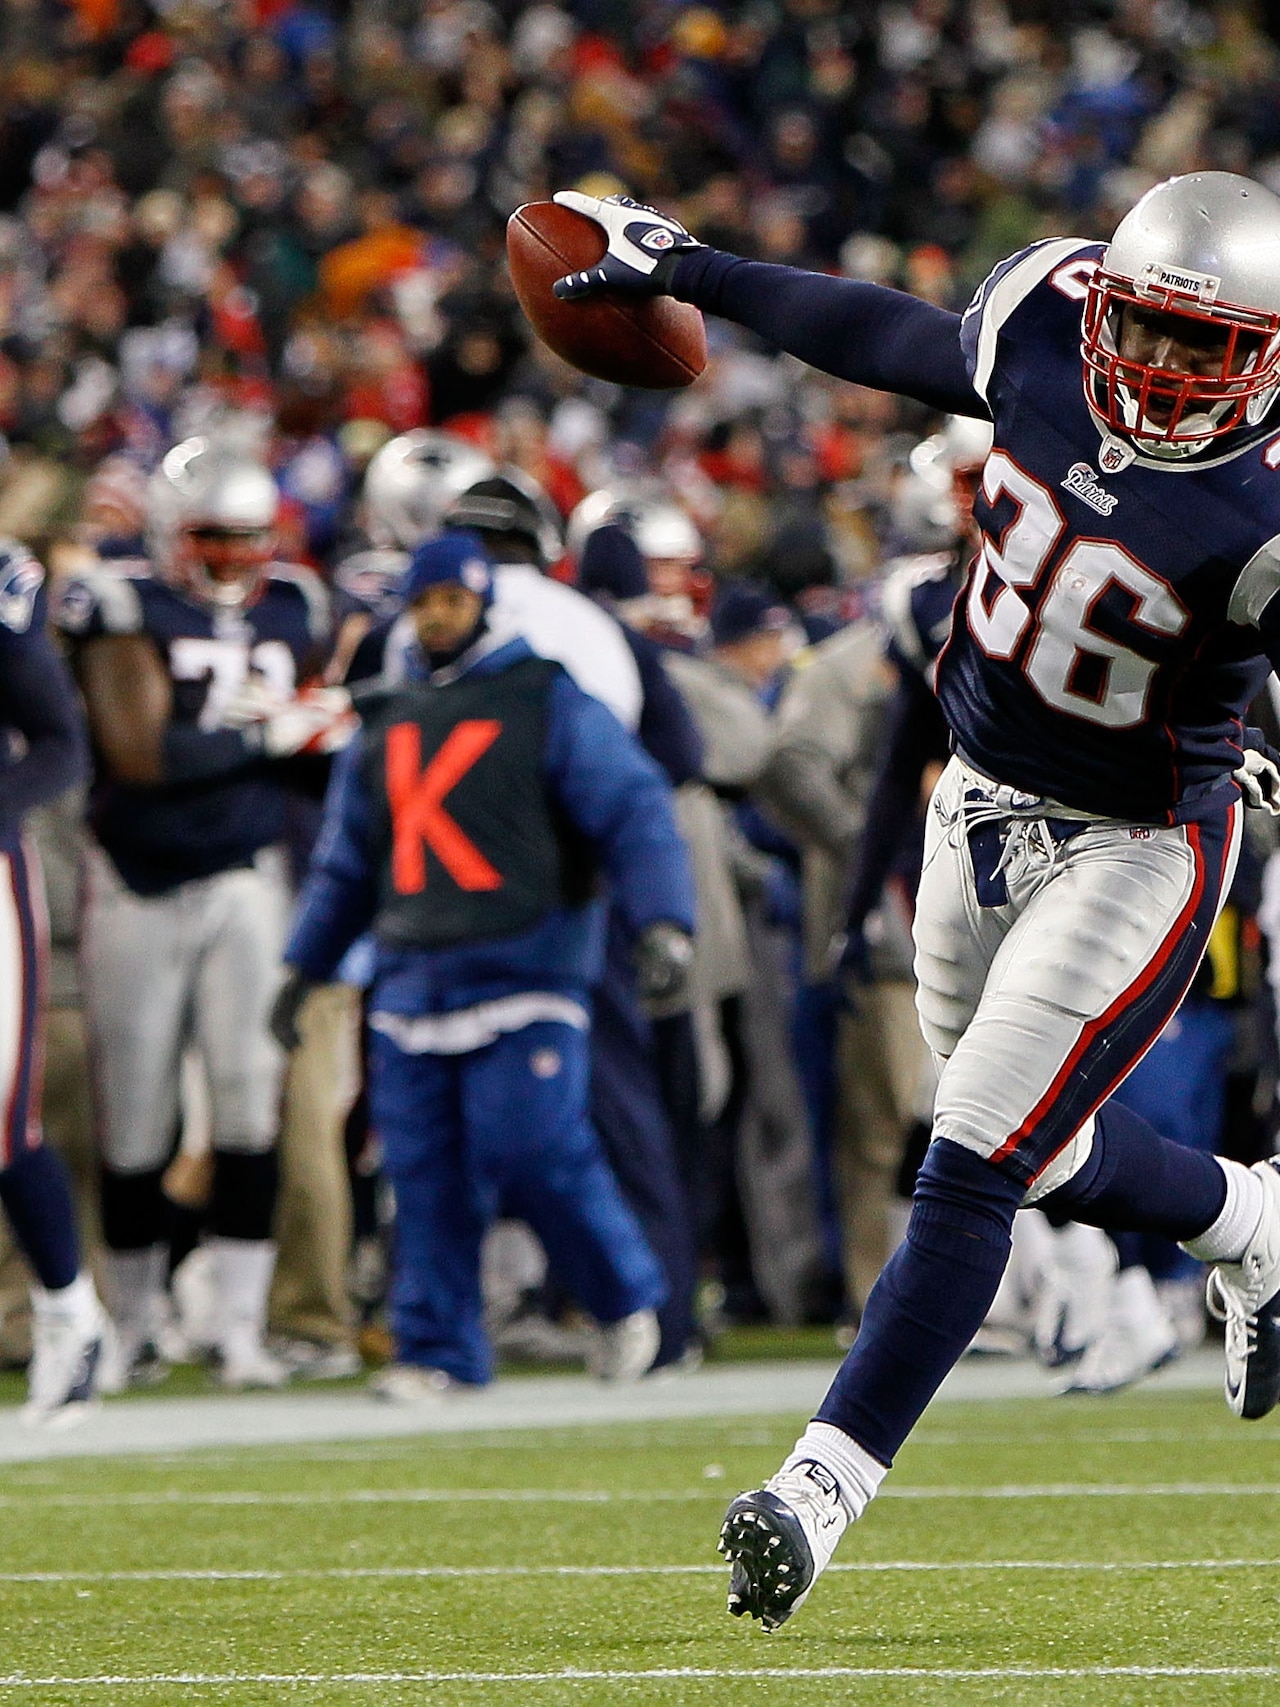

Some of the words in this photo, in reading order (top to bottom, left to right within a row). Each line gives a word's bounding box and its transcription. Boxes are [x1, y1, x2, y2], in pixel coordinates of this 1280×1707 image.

[1160, 272, 1200, 291] PATRIOTS
[1060, 469, 1118, 516] Patriots
[967, 447, 1192, 732] 36
[384, 718, 502, 895] K
